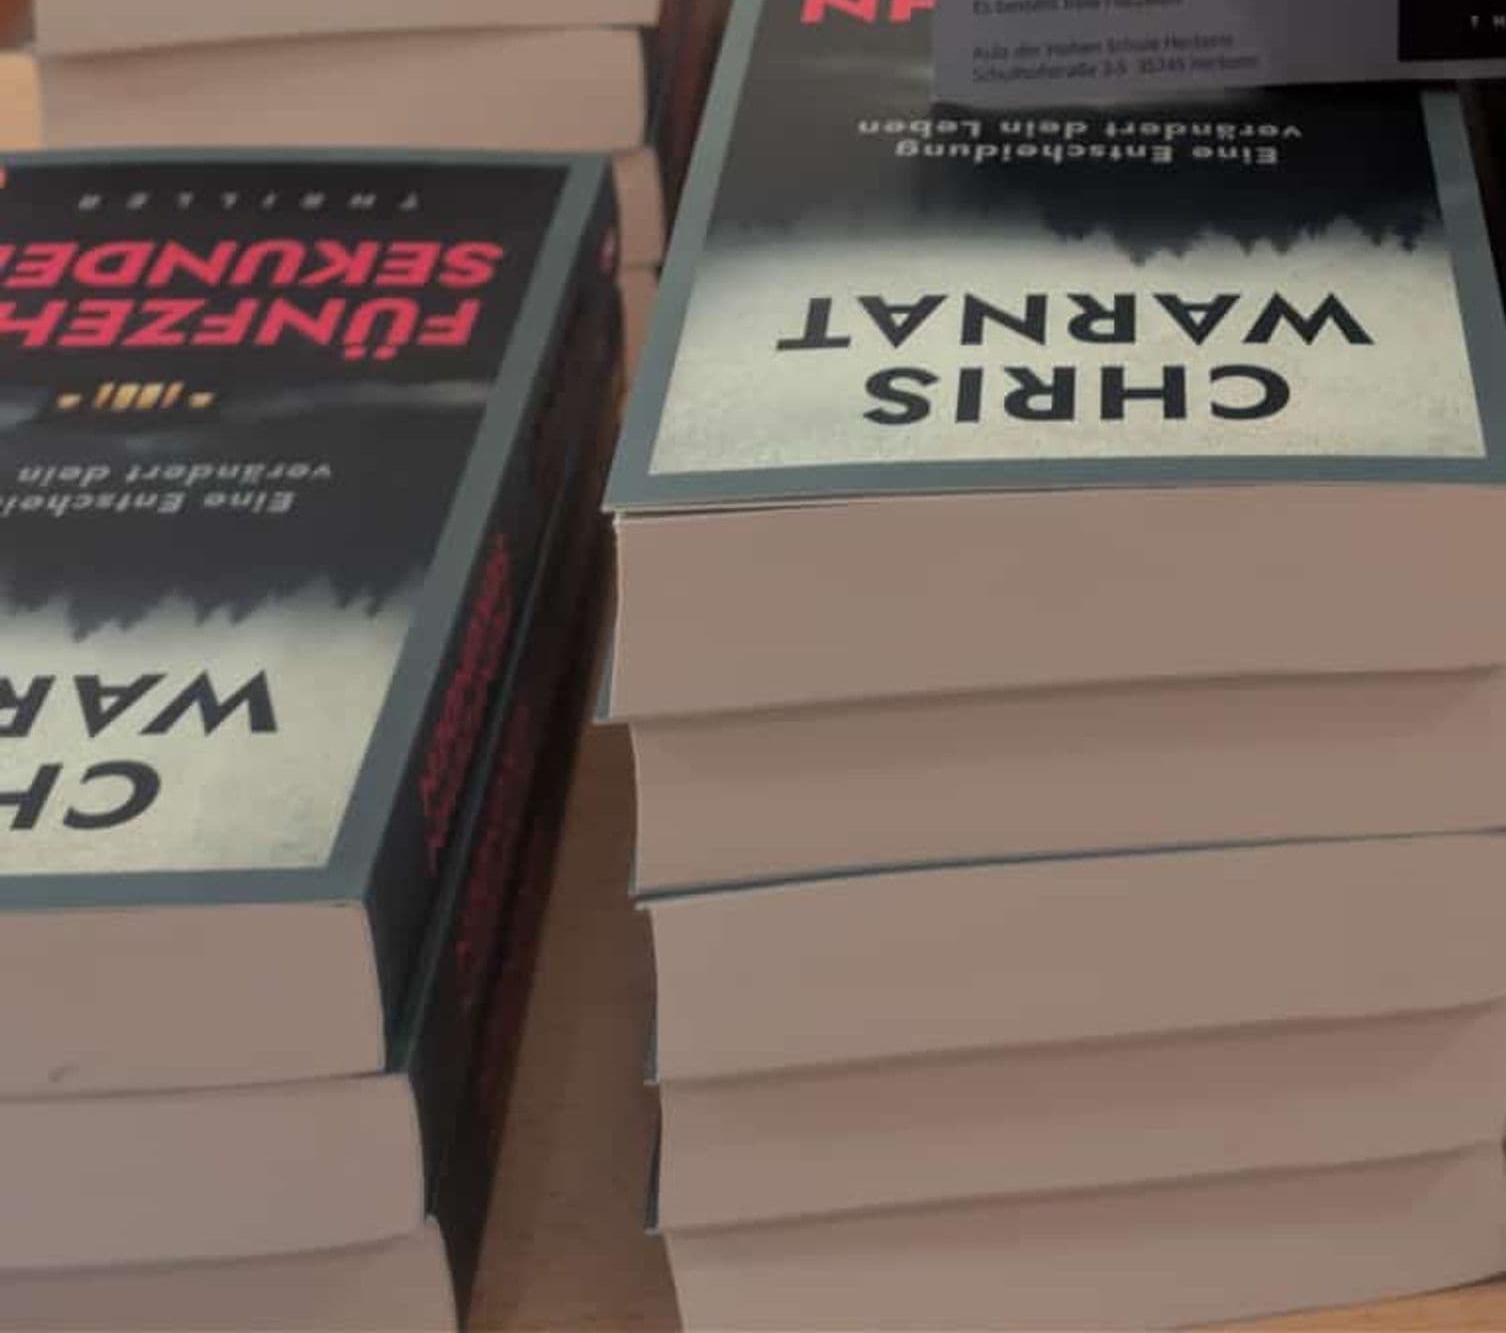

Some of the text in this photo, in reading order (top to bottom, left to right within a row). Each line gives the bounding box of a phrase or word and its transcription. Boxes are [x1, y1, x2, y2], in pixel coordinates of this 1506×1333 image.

[857, 118, 1303, 141] verändert dein Leben
[894, 138, 1279, 166] Eine Entscheidung
[79, 192, 419, 211] THRILLER
[0, 240, 504, 289] SEKUNDE
[776, 290, 1375, 351] WARNAT
[863, 364, 1291, 426] CHRIS
[18, 462, 332, 487] verändert dein
[203, 491, 296, 514] Eine
